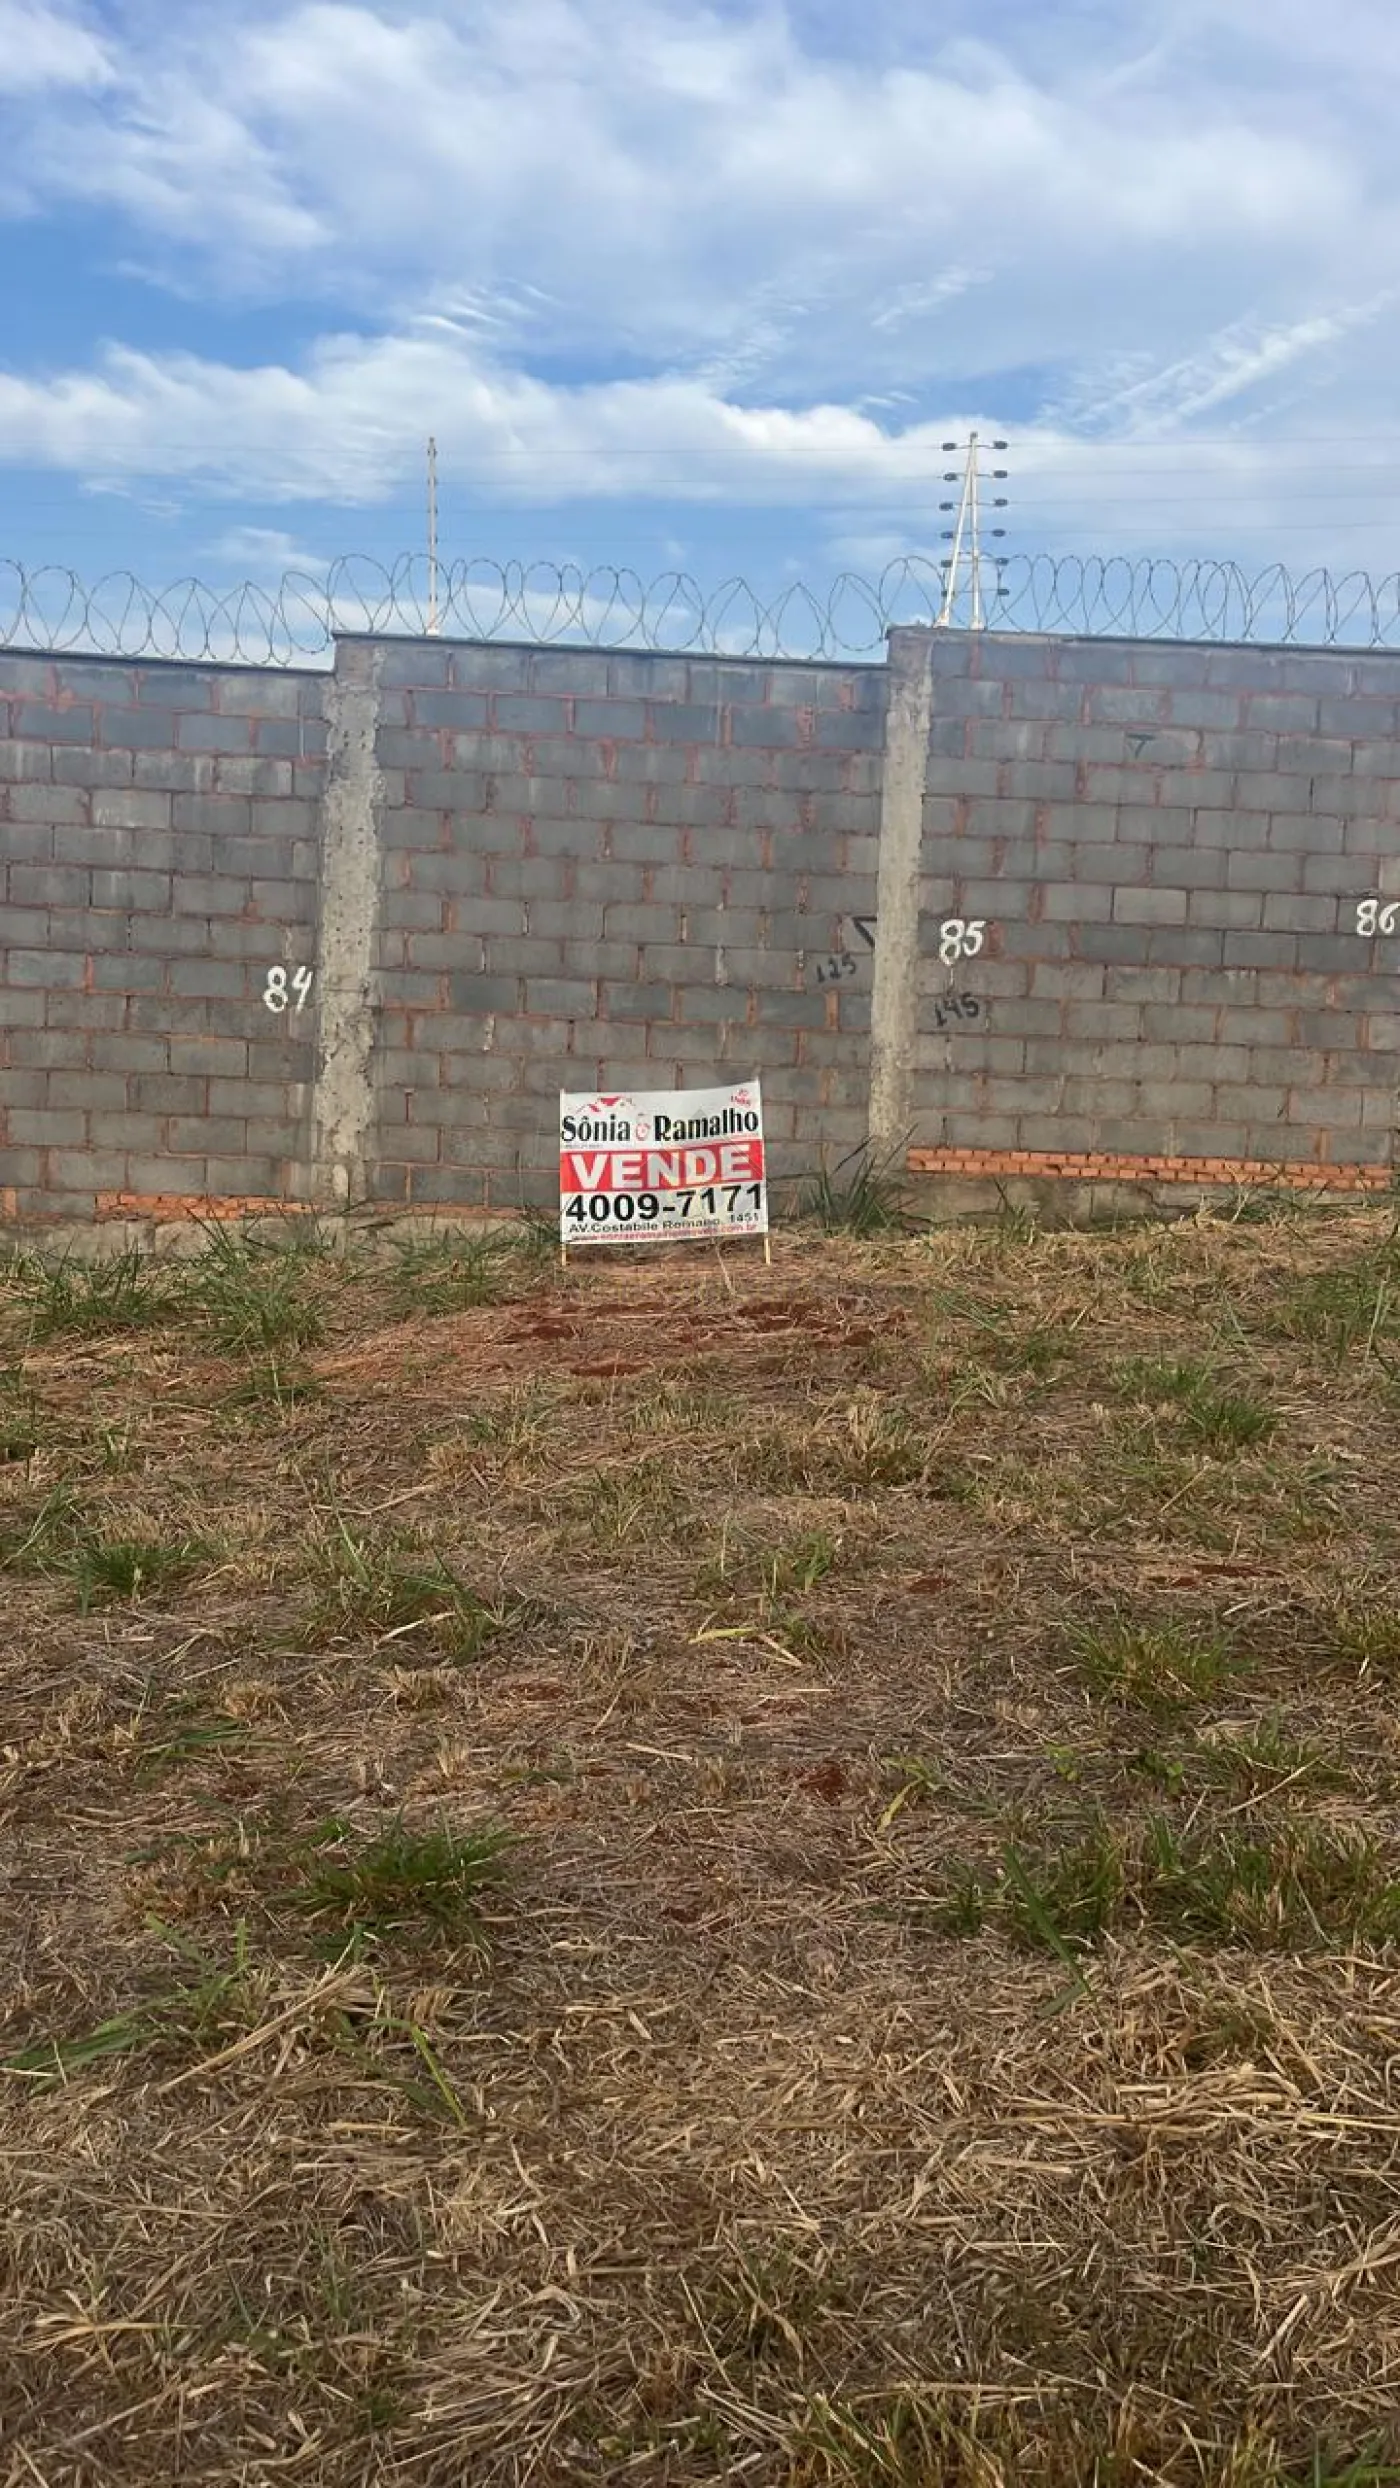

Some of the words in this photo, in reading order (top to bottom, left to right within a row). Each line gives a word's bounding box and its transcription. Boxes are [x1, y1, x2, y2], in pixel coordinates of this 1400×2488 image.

[939, 919, 988, 966] 85
[263, 965, 313, 1014] 84
[561, 1113, 631, 1142] Sônia
[655, 1107, 759, 1142] Ramalho
[570, 1145, 753, 1189] VENDE
[566, 1184, 762, 1222] 4009-7171
